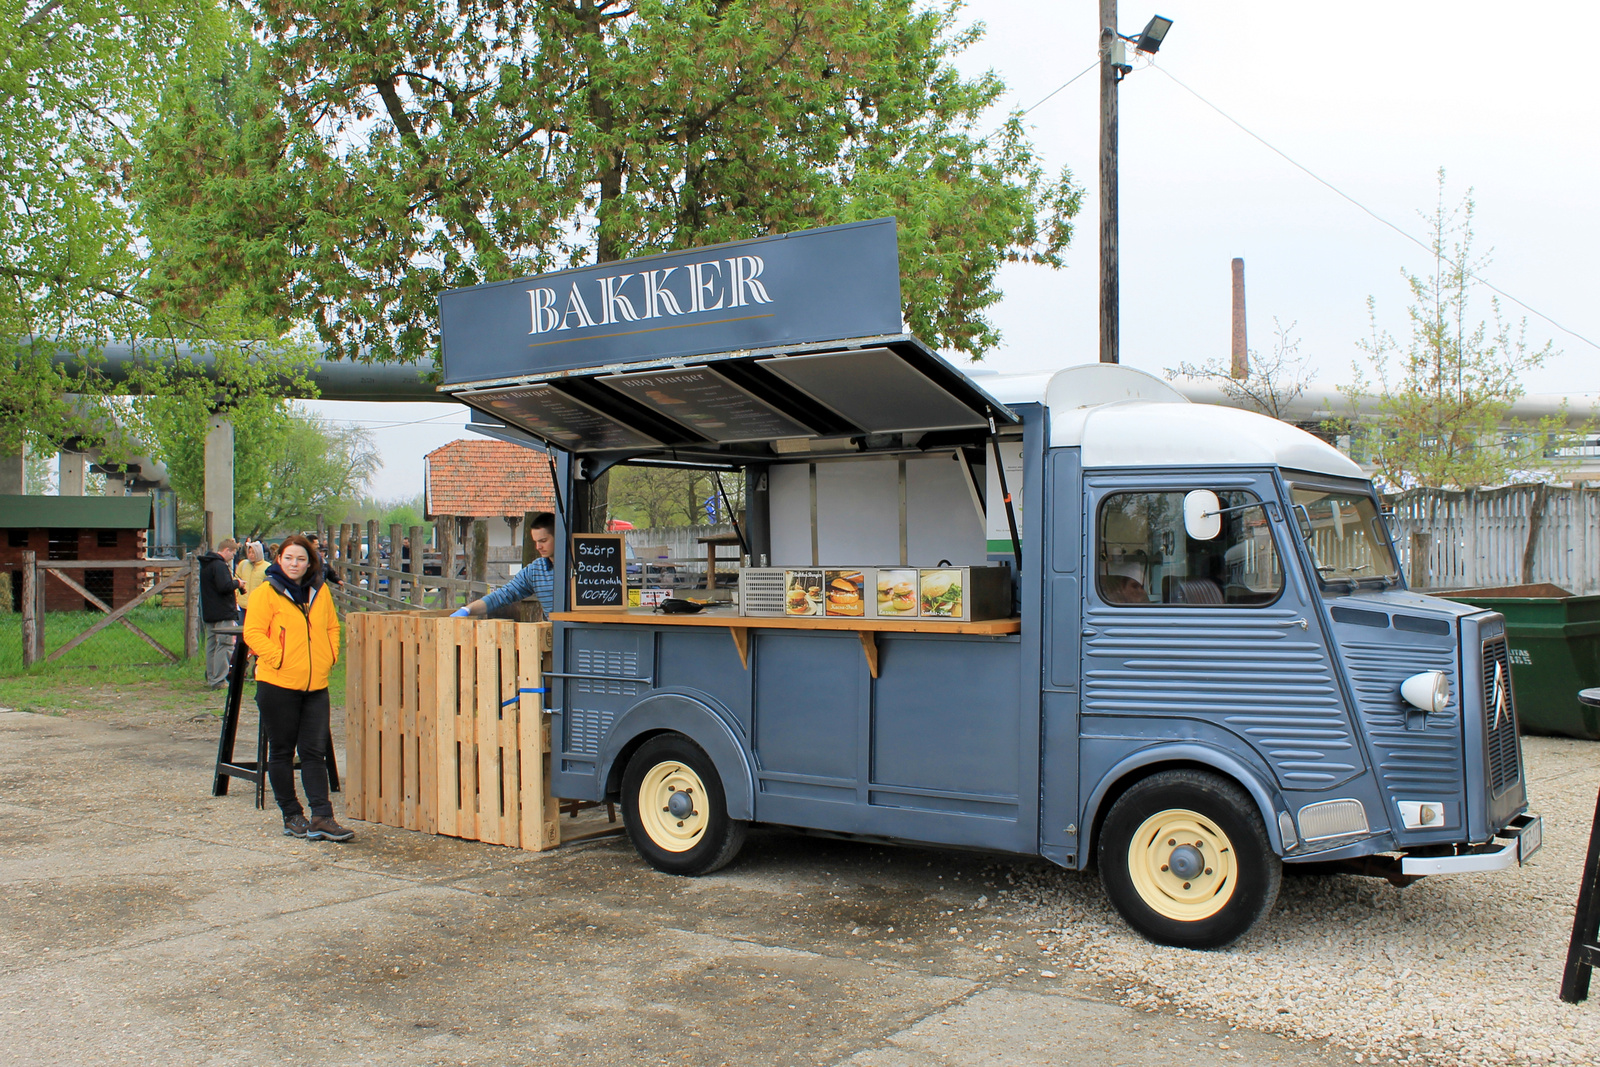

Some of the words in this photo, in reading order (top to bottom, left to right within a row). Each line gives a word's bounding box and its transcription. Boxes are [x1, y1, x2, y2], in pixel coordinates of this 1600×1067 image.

[527, 255, 774, 335] BAKKER
[622, 375, 655, 388] BBQ
[655, 372, 705, 384] Burger
[469, 393, 509, 402] Bakker
[509, 388, 552, 399] Burger
[579, 543, 615, 558] Szörp
[578, 562, 614, 574] Bodza
